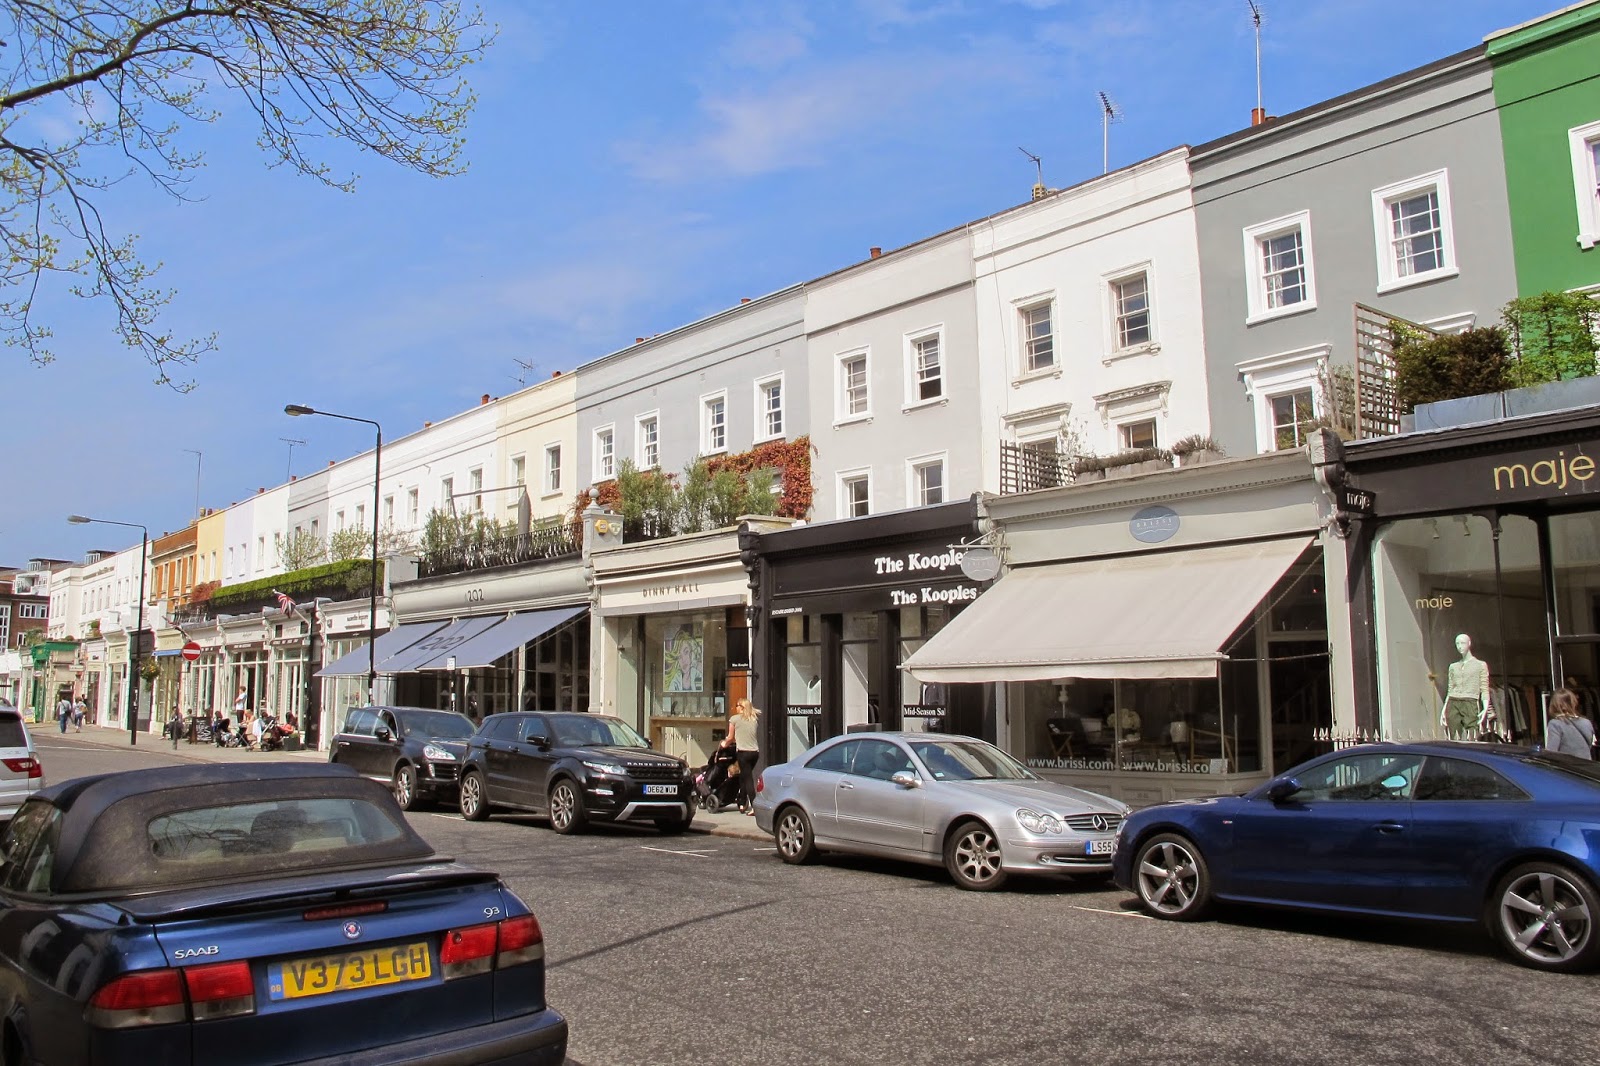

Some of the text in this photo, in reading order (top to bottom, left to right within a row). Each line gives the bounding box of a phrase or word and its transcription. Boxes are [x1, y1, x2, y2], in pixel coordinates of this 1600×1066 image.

[1493, 450, 1596, 491] maje
[1346, 491, 1371, 510] maje
[874, 548, 968, 575] The Koople
[467, 588, 485, 602] 202
[642, 583, 699, 598] DINNY HALL
[890, 584, 978, 605] The Kooples
[1415, 595, 1453, 611] maje
[786, 706, 822, 715] Mid-Season Sal
[903, 706, 946, 716] Mid-Season Sal
[1027, 756, 1114, 770] www.brissi.com
[1122, 758, 1209, 774] www.brissi.co
[1091, 841, 1112, 852] LS55
[174, 945, 220, 959] SAAB
[290, 946, 427, 991] V373 LGH
